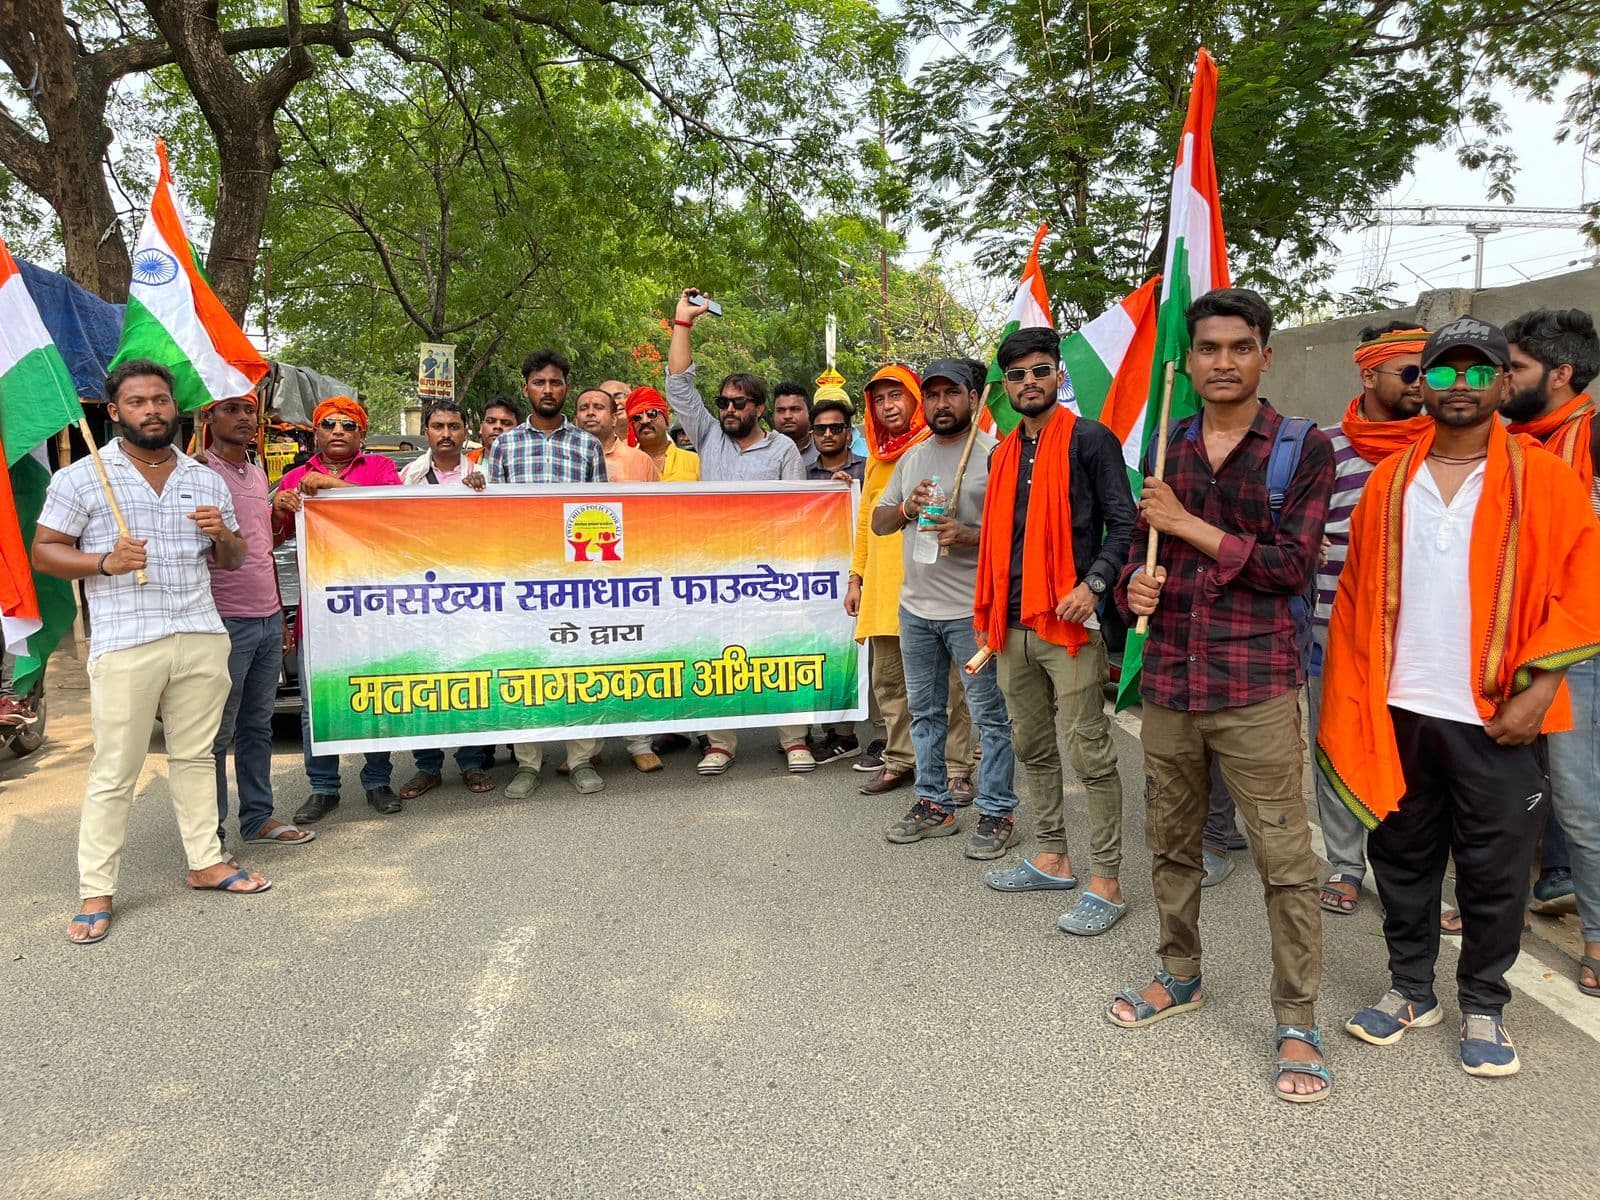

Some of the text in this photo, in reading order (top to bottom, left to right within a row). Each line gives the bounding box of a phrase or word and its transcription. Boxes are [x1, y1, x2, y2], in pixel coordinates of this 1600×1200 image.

[1436, 334, 1489, 344] RACING
[1438, 319, 1490, 339] KTM
[570, 507, 586, 523] CHILD
[586, 505, 609, 514] POLICY
[325, 564, 840, 617] जनसंख्या समाधान फाउन्डेशन
[549, 622, 645, 645] के द्वारा
[349, 669, 493, 716] मतदाता
[691, 644, 826, 697] अभियान
